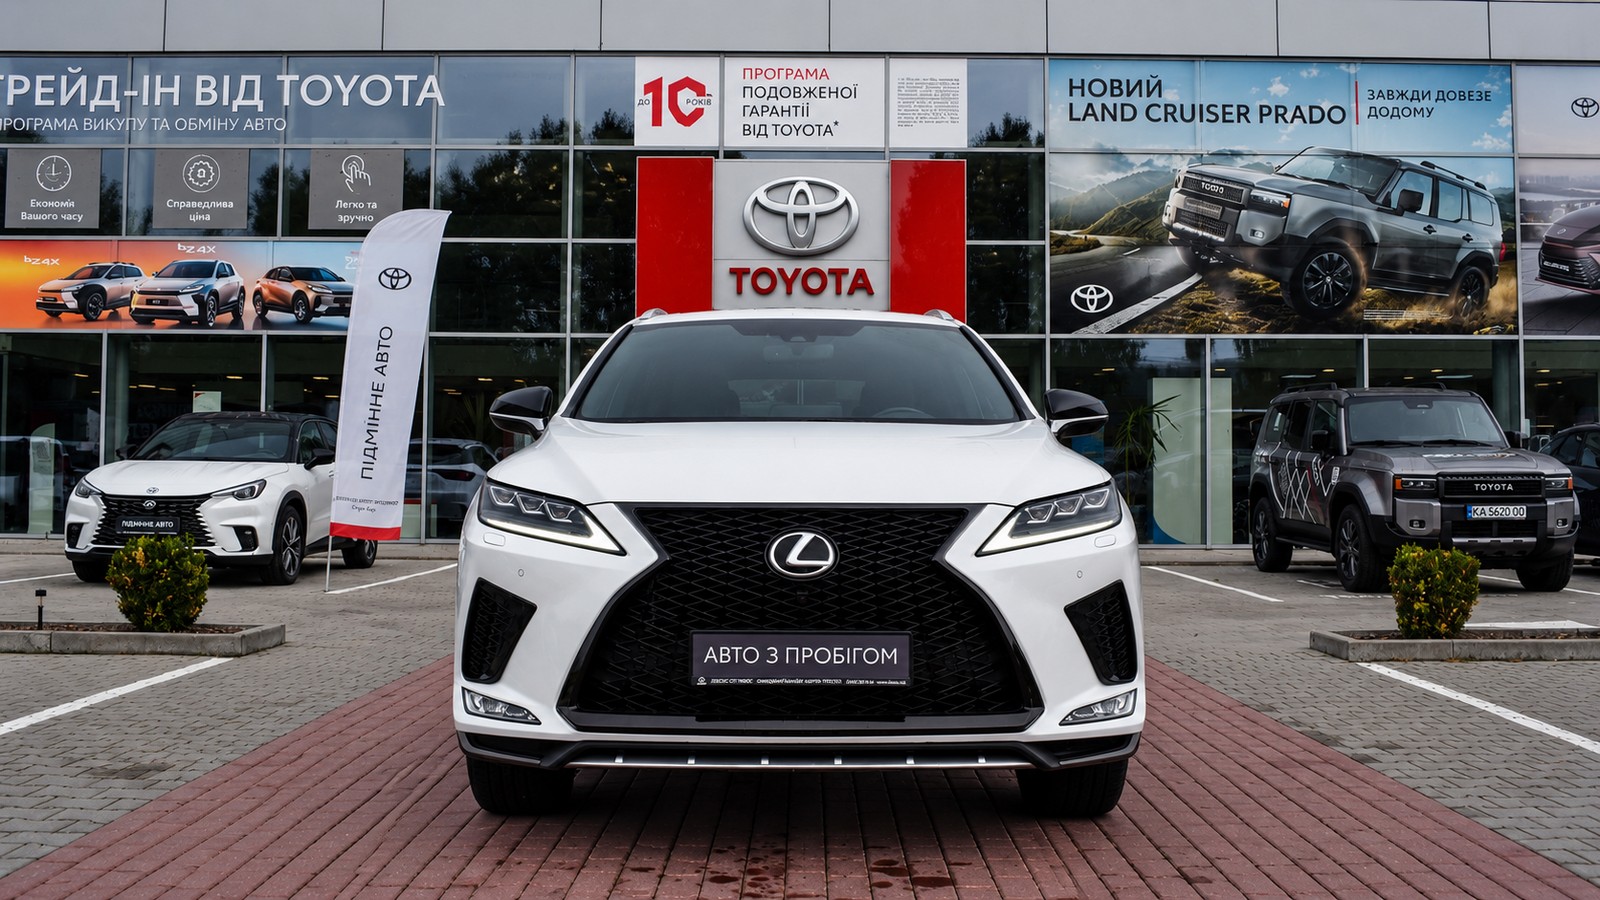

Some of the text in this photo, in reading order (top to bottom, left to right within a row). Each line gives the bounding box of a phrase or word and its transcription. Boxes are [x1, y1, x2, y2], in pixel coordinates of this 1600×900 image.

[742, 67, 830, 80] ПРОГРАМА
[0, 66, 446, 112] РЕЙД-ІН ВІД TOYOTA
[742, 83, 859, 101] ПОДОВЖЕНОЇ
[1068, 74, 1162, 98] НОВИЙ
[686, 98, 712, 106] РОКІВ
[1367, 89, 1492, 103] ЗАВЖДИ ДОВЕЗЕ
[1068, 102, 1347, 125] LAND CRUISER PRADO
[1367, 106, 1435, 119] ДОДОМУ
[83, 118, 148, 131] ВИКУПУ
[151, 118, 171, 131] ТА
[175, 115, 240, 131] ОБМІНУ
[243, 118, 287, 131] АВТО
[742, 124, 769, 138] ВІД
[166, 199, 234, 209] Справедлива
[20, 211, 84, 223] Вашого часу
[189, 211, 211, 222] ціна
[337, 213, 374, 224] зручно
[729, 266, 875, 296] TOYOTA
[360, 381, 385, 480] ПІДМІННЕ
[374, 326, 393, 376] АВТО
[1474, 483, 1514, 491] TOYOTA
[703, 646, 898, 665] АВТО З ПРОБІГОМ
